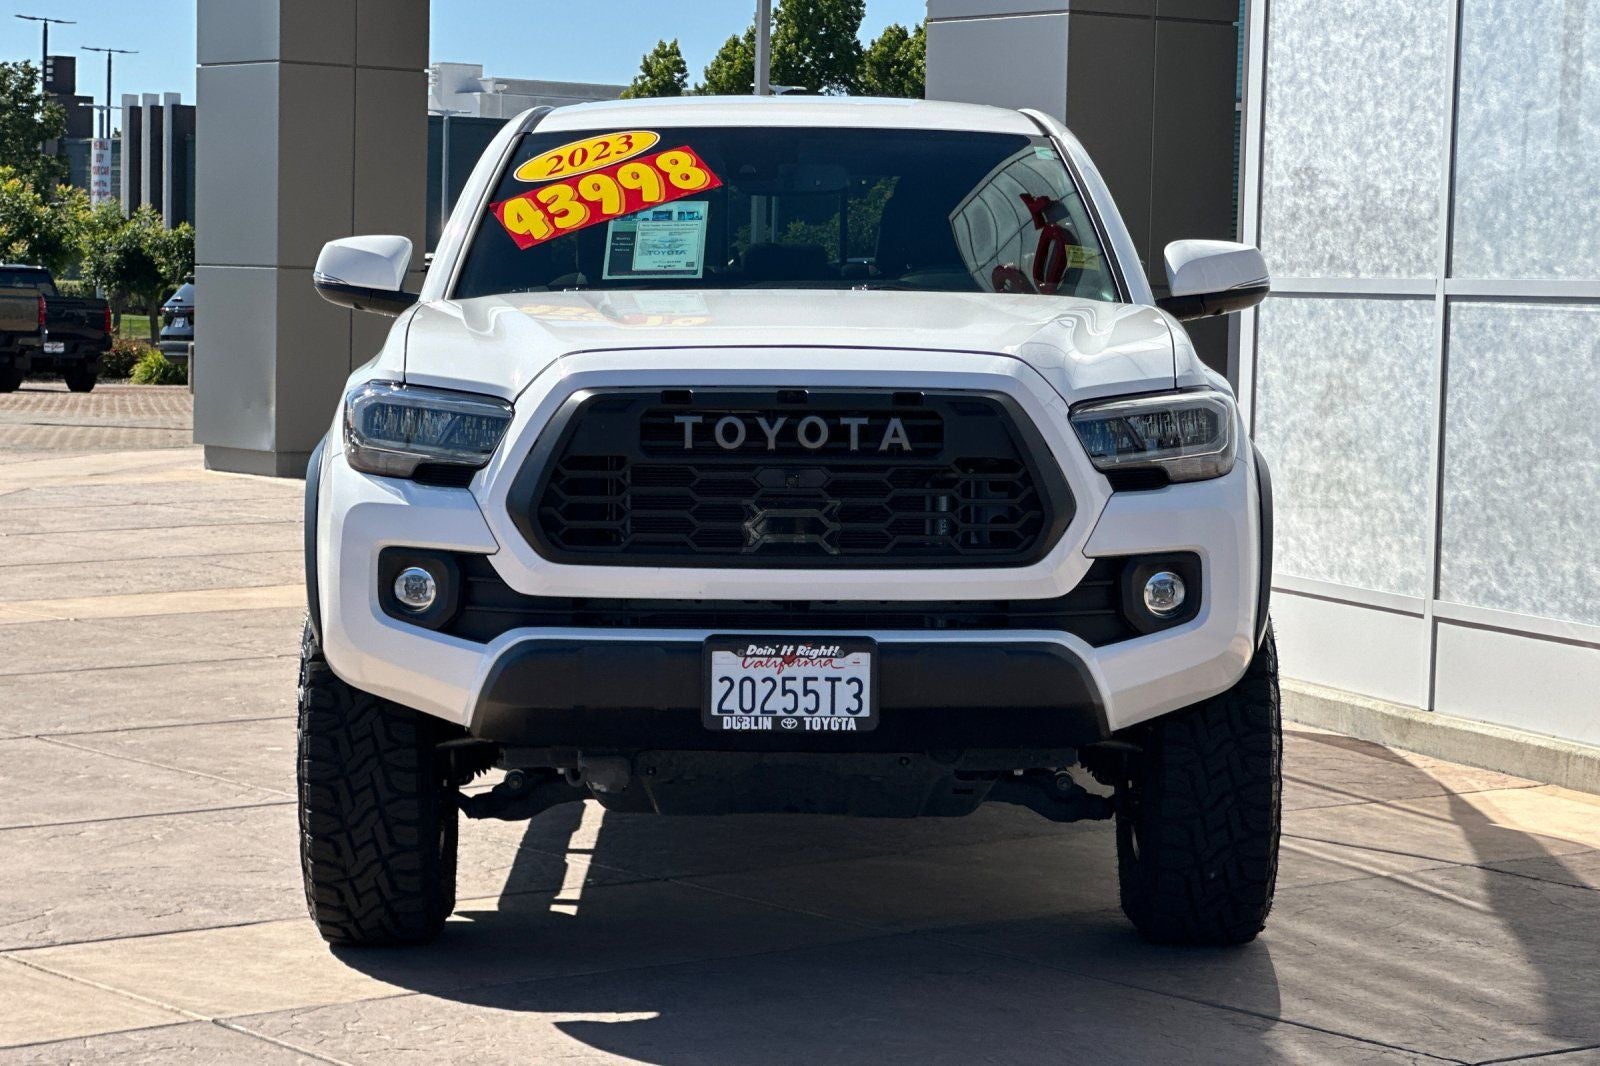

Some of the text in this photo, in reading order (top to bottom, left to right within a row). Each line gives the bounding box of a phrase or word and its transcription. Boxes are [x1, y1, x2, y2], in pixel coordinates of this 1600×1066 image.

[546, 134, 634, 177] 2023
[503, 150, 711, 240] 43998
[673, 415, 912, 451] TOYOTA
[742, 657, 845, 675] California
[746, 644, 841, 659] Doin' It Right!
[717, 676, 864, 715] 20255T3
[722, 716, 857, 731] DUBLIN TOYOTA
